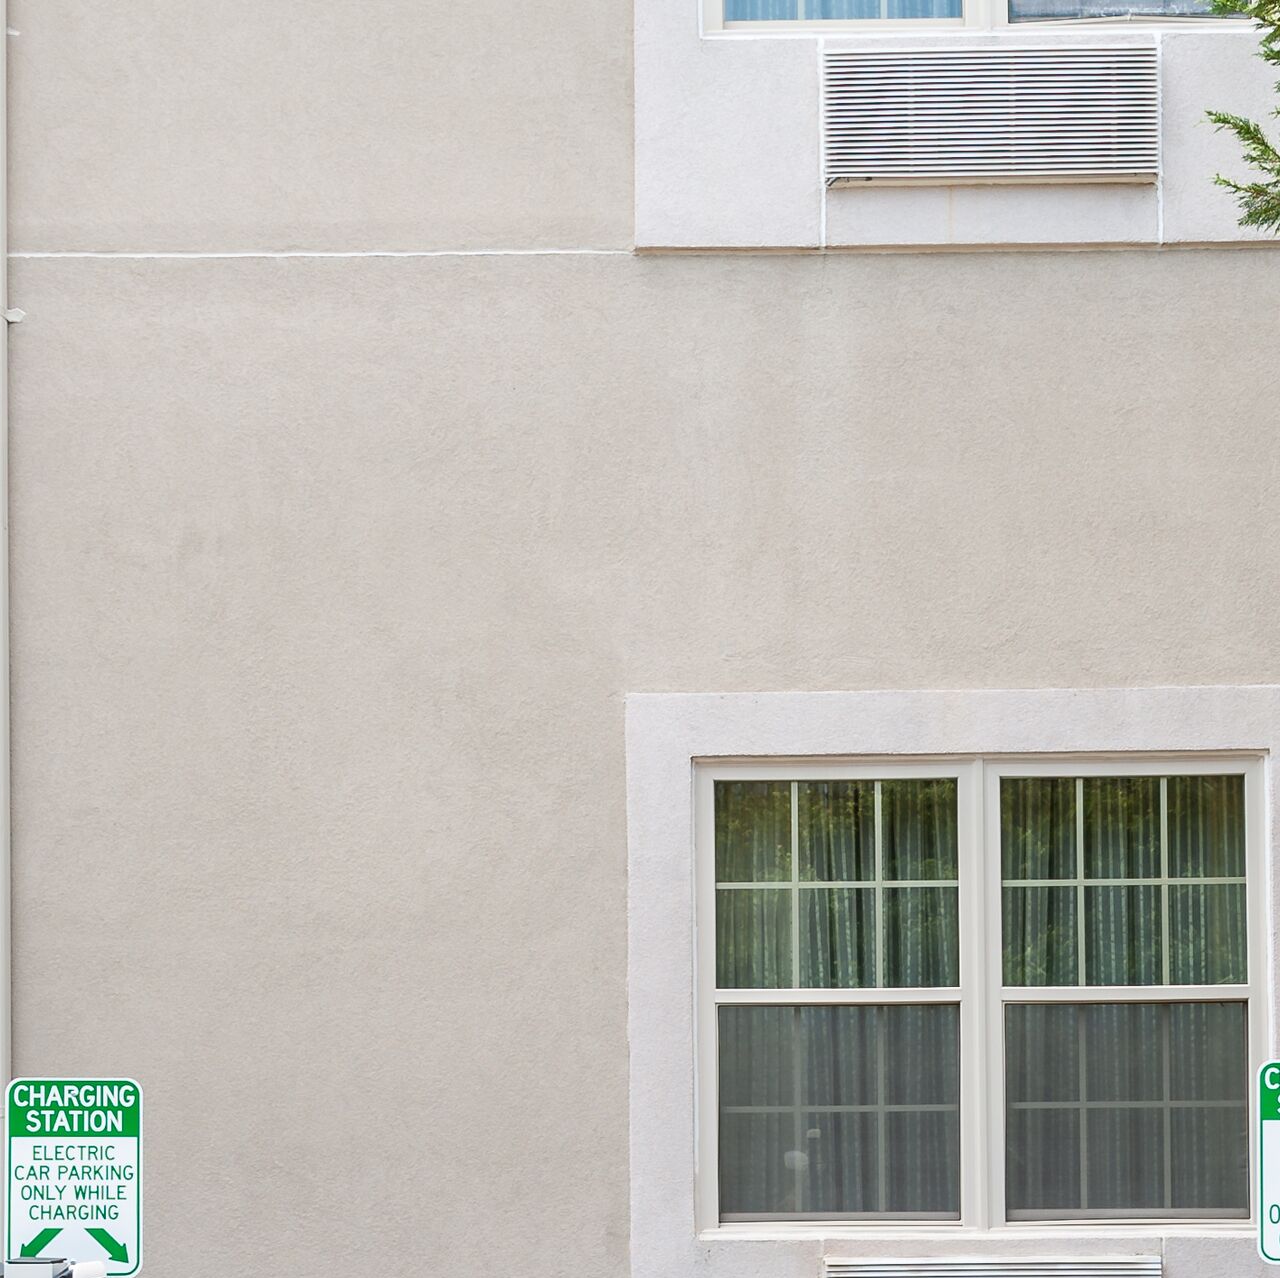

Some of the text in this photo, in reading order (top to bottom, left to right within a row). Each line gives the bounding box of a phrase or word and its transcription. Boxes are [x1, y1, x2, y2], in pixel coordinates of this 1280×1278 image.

[13, 1085, 136, 1107] CHARGING
[25, 1110, 123, 1132] STATION
[32, 1145, 116, 1161] ELECTRIC
[14, 1165, 134, 1180] CAR PARKING
[20, 1185, 127, 1201] ONLY WHILE
[28, 1205, 120, 1220] CHARGING
